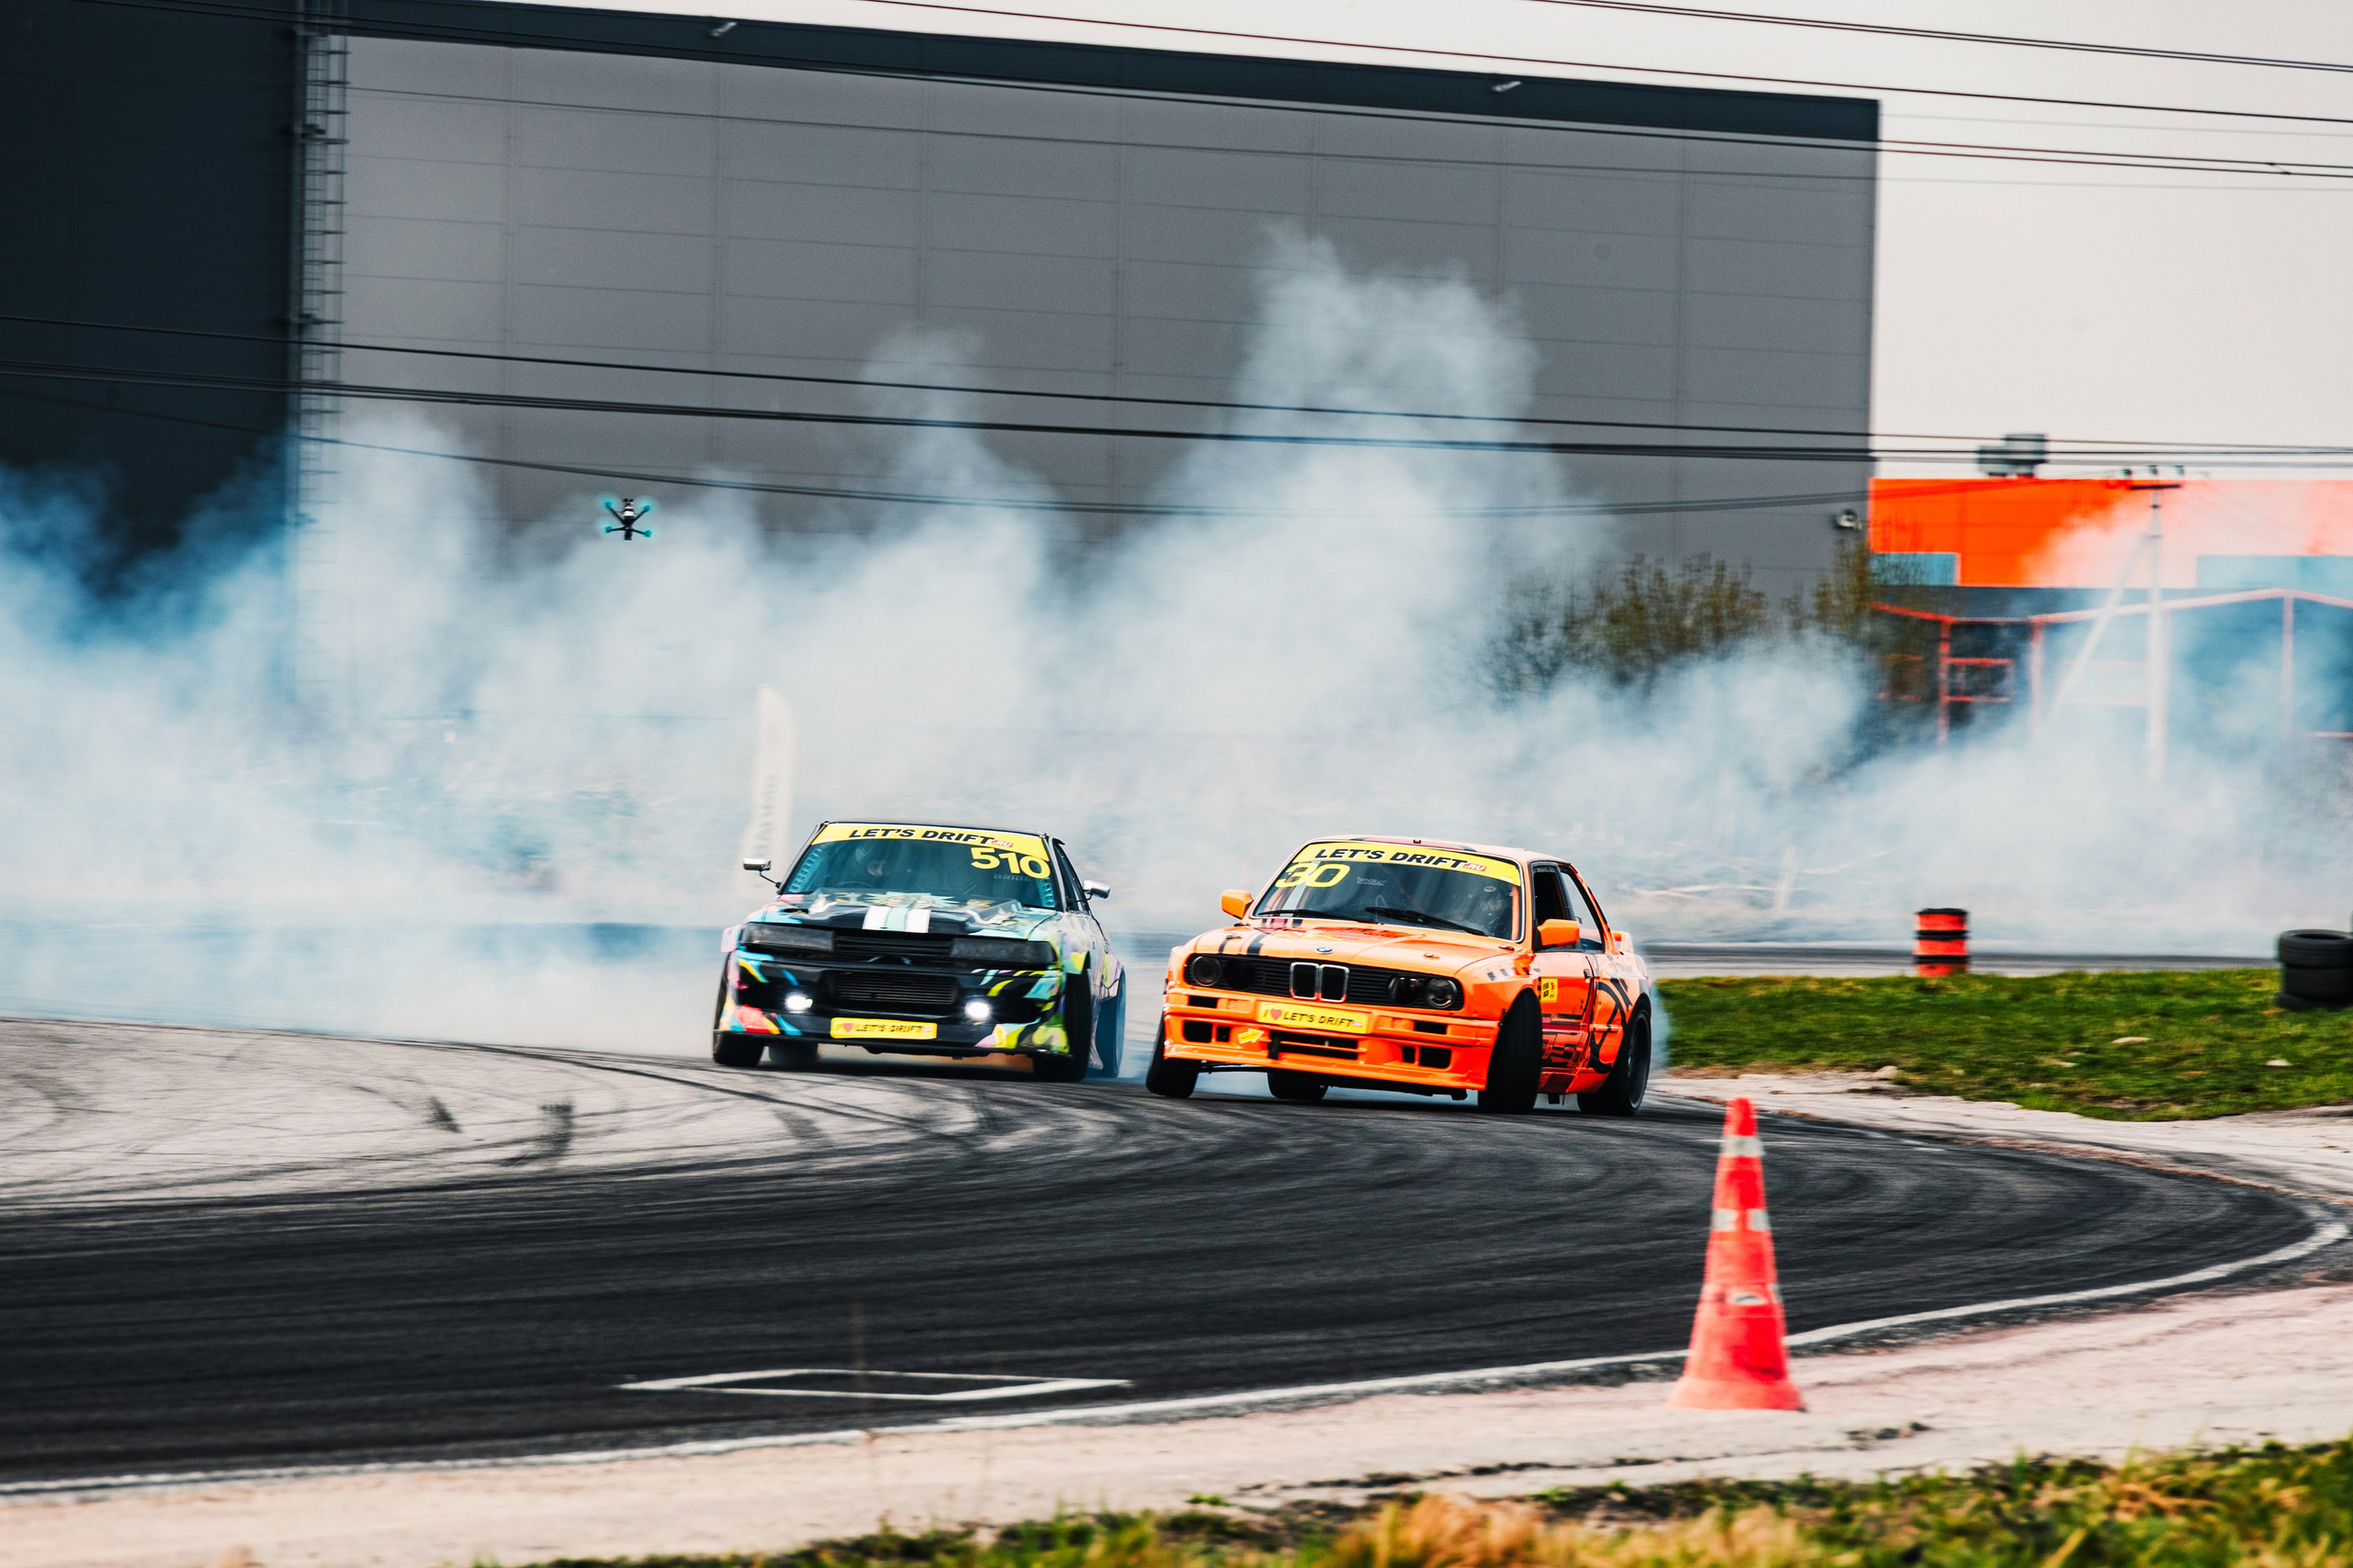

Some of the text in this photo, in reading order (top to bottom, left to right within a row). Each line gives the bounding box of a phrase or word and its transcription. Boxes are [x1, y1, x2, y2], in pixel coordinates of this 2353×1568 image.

[849, 828, 915, 838] LET'S
[1315, 848, 1385, 859] LET'S
[971, 846, 1051, 880] 510
[1275, 862, 1351, 889] 30
[1283, 1011, 1314, 1023] LET'S
[1318, 1016, 1354, 1027] DRIFT
